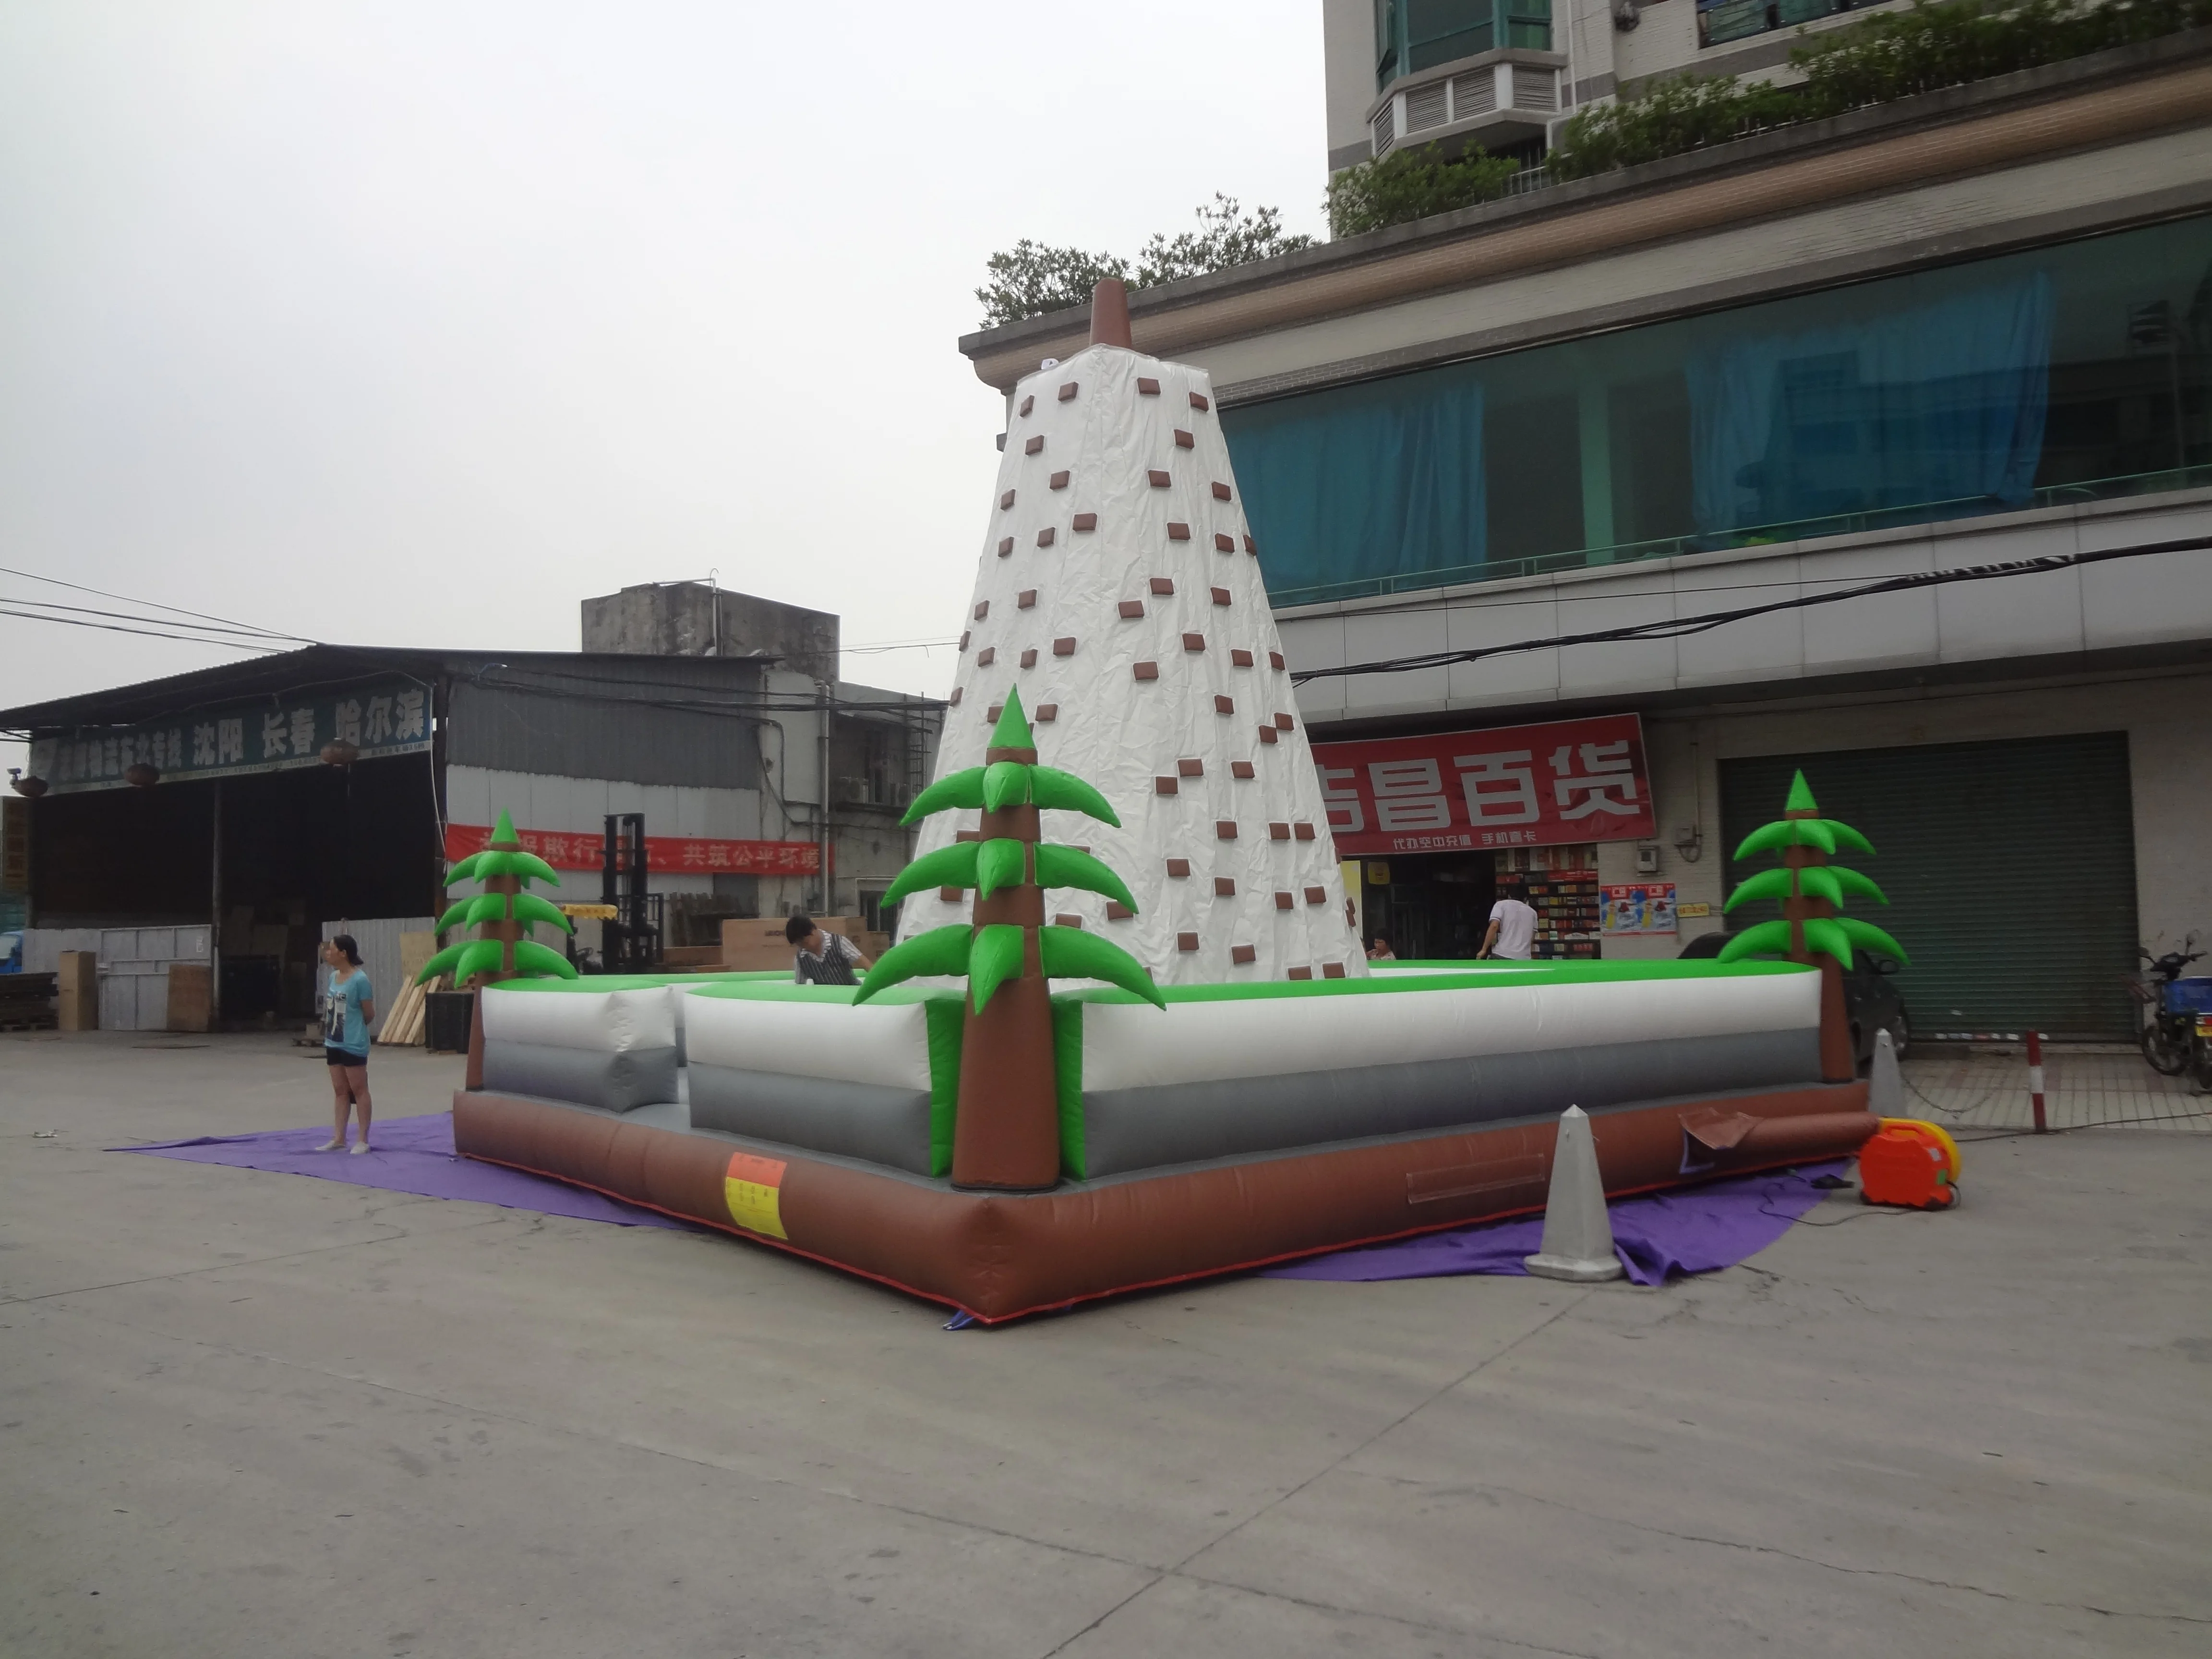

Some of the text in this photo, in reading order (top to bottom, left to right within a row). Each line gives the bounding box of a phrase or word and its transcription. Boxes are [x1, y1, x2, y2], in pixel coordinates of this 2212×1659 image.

[193, 718, 243, 766] 沈阳
[262, 708, 315, 758] 长春
[336, 688, 423, 746] 哈尔滨
[1393, 834, 1472, 850] 代办空中充值
